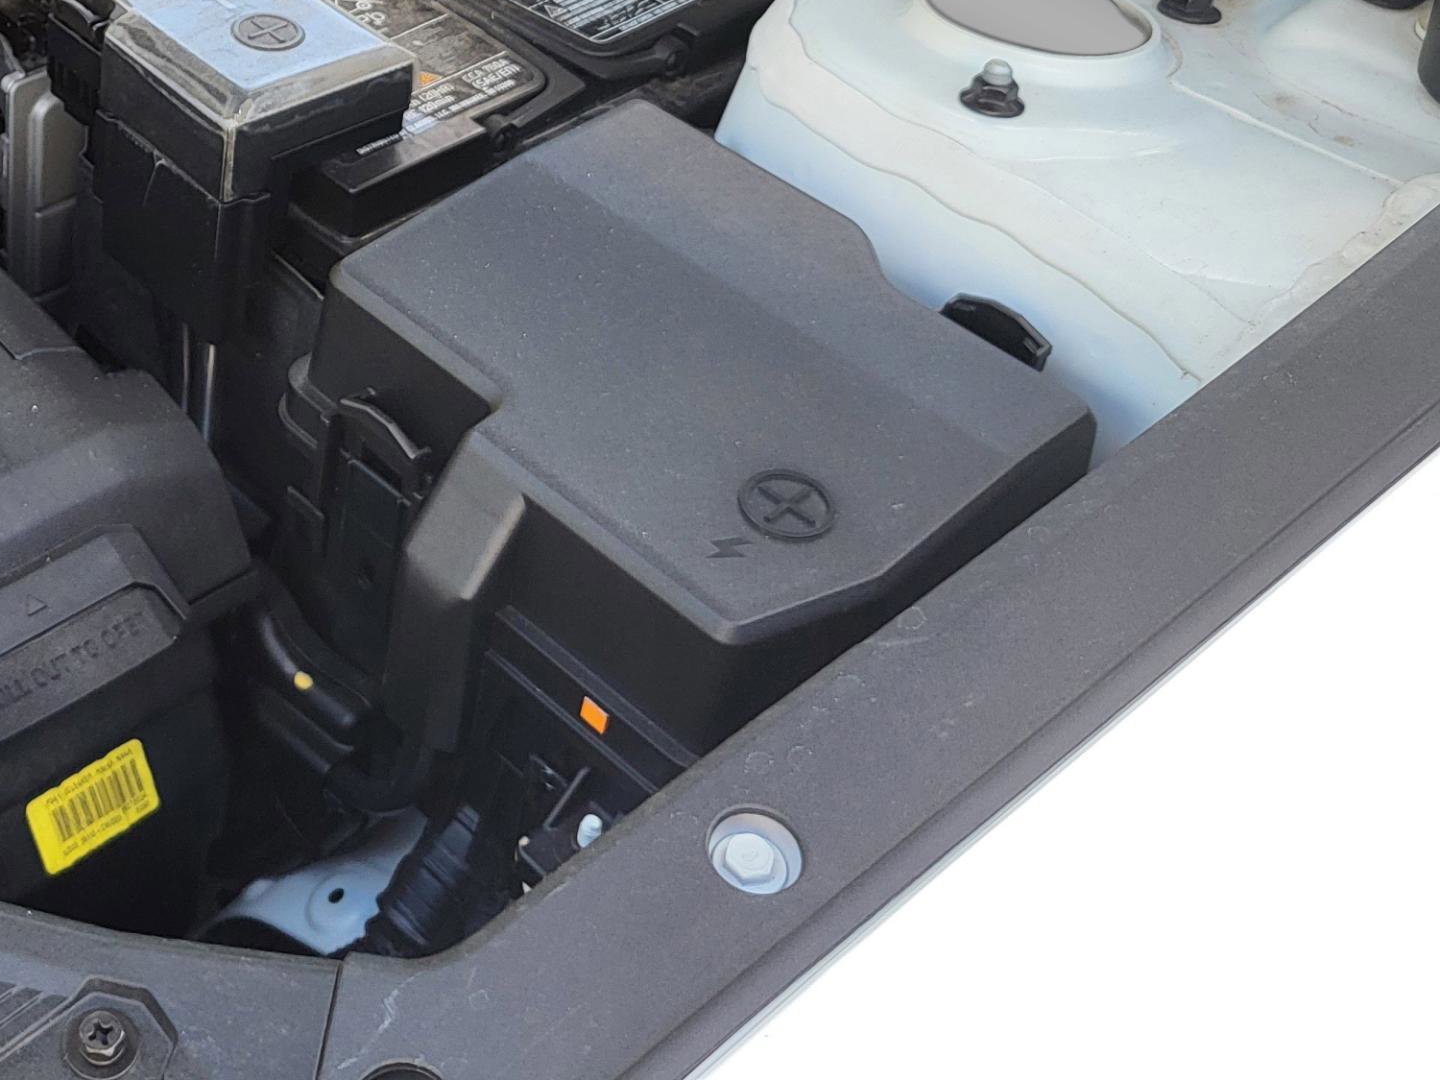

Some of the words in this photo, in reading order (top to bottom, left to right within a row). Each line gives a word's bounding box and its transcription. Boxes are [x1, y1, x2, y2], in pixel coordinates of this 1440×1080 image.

[461, 68, 486, 84] CCA
[31, 652, 71, 688] OUT
[69, 638, 100, 664] TO
[101, 612, 146, 650] OPE
